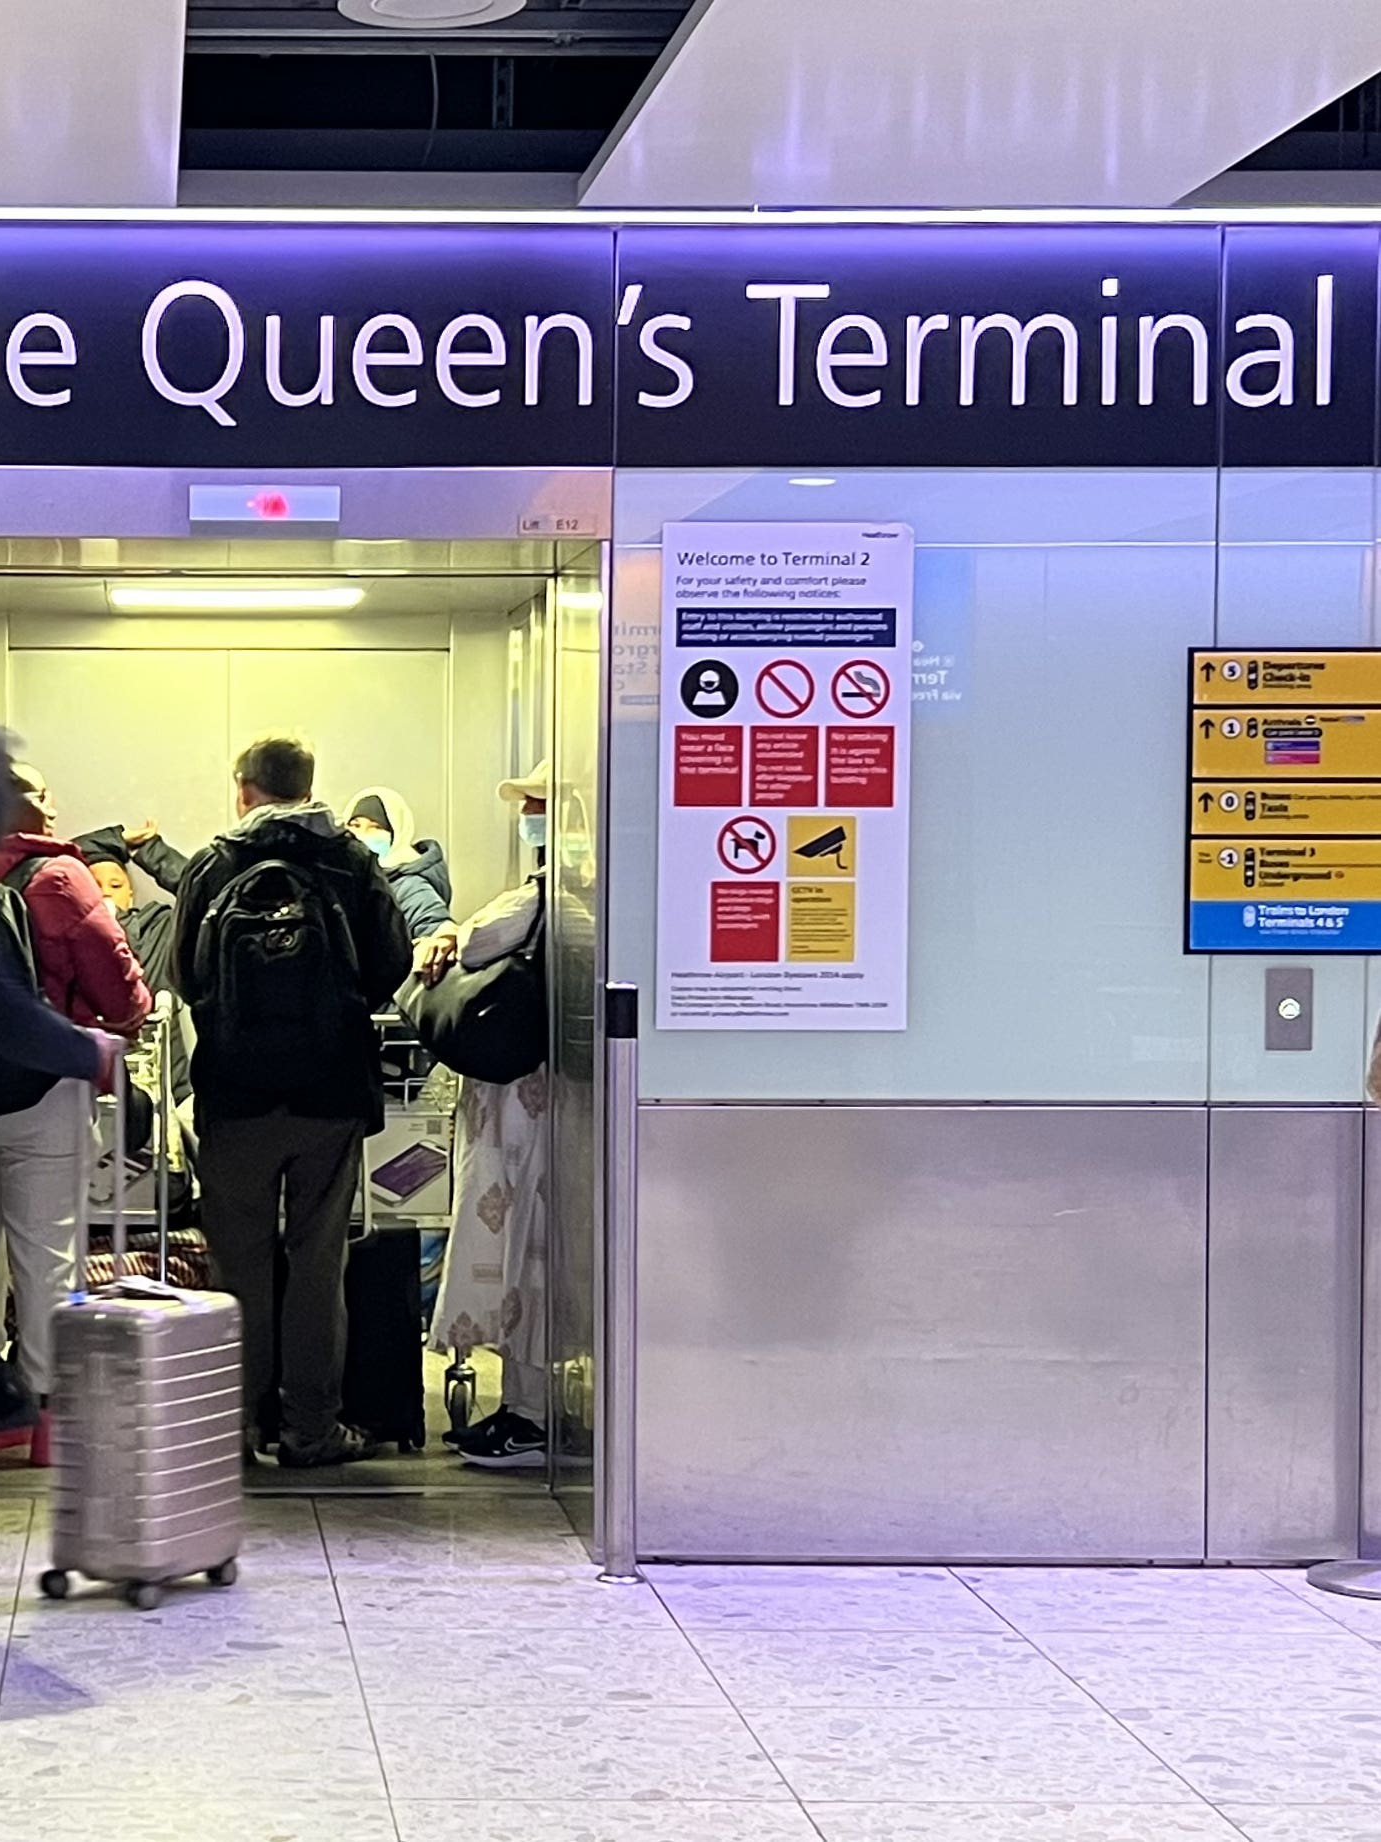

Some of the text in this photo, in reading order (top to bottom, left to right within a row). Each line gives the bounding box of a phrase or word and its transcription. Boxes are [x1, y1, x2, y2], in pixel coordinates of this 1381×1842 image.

[141, 280, 695, 427] Queen's
[745, 275, 1334, 407] Terminal
[556, 519, 578, 530] E12
[676, 552, 870, 566] Welcome to Terminal 2
[676, 575, 867, 588] For your safety and comfort please
[722, 589, 740, 599] the
[743, 589, 796, 601] following
[1227, 666, 1236, 676] 5
[1227, 723, 1235, 734] 1
[1225, 796, 1235, 808] 0
[1258, 905, 1350, 915] Trains to London
[1258, 917, 1315, 928] Terminals
